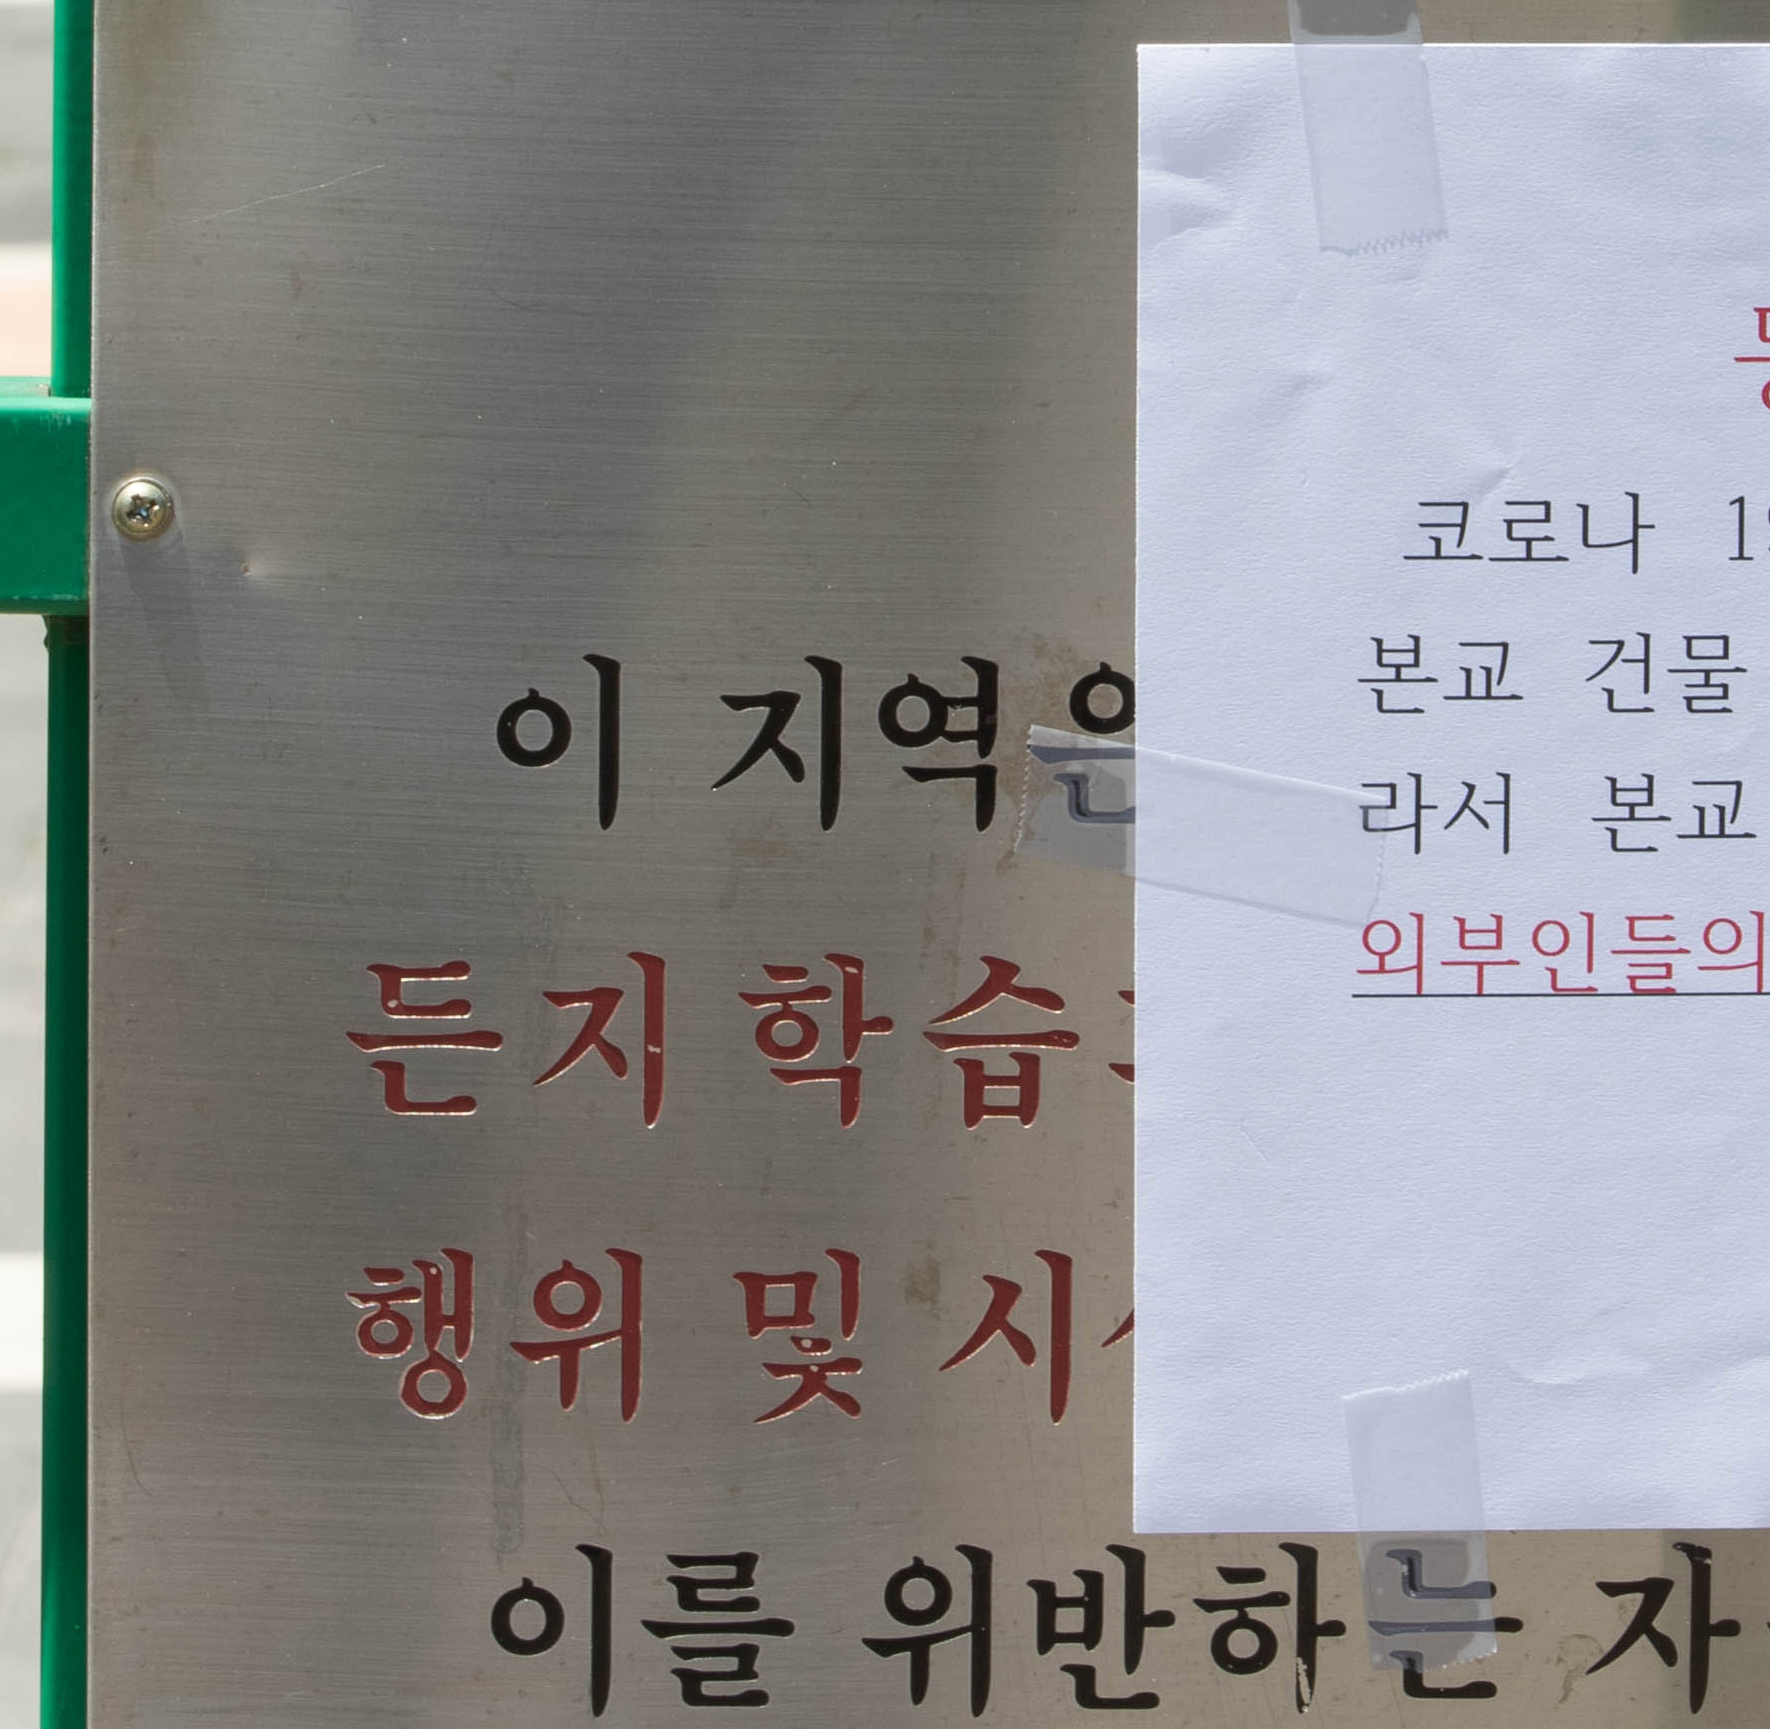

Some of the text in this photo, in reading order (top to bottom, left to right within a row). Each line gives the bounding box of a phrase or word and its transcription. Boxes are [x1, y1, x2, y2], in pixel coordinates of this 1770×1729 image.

[1403, 492, 1655, 574] 코로나
[1357, 634, 1525, 713] 본교
[1586, 632, 1748, 714] 건물
[496, 654, 622, 831] 이
[1357, 771, 1516, 856] 라서
[1592, 773, 1759, 853] 본교
[1355, 907, 1769, 995] 외부인들의
[347, 951, 667, 1128] 든지
[738, 953, 1135, 1128] 학습
[346, 1247, 642, 1424] 행위
[732, 1248, 864, 1424] 및
[939, 1248, 1135, 1424] 시
[490, 1542, 796, 1716] 이를
[863, 1542, 1516, 1716] 위반하는
